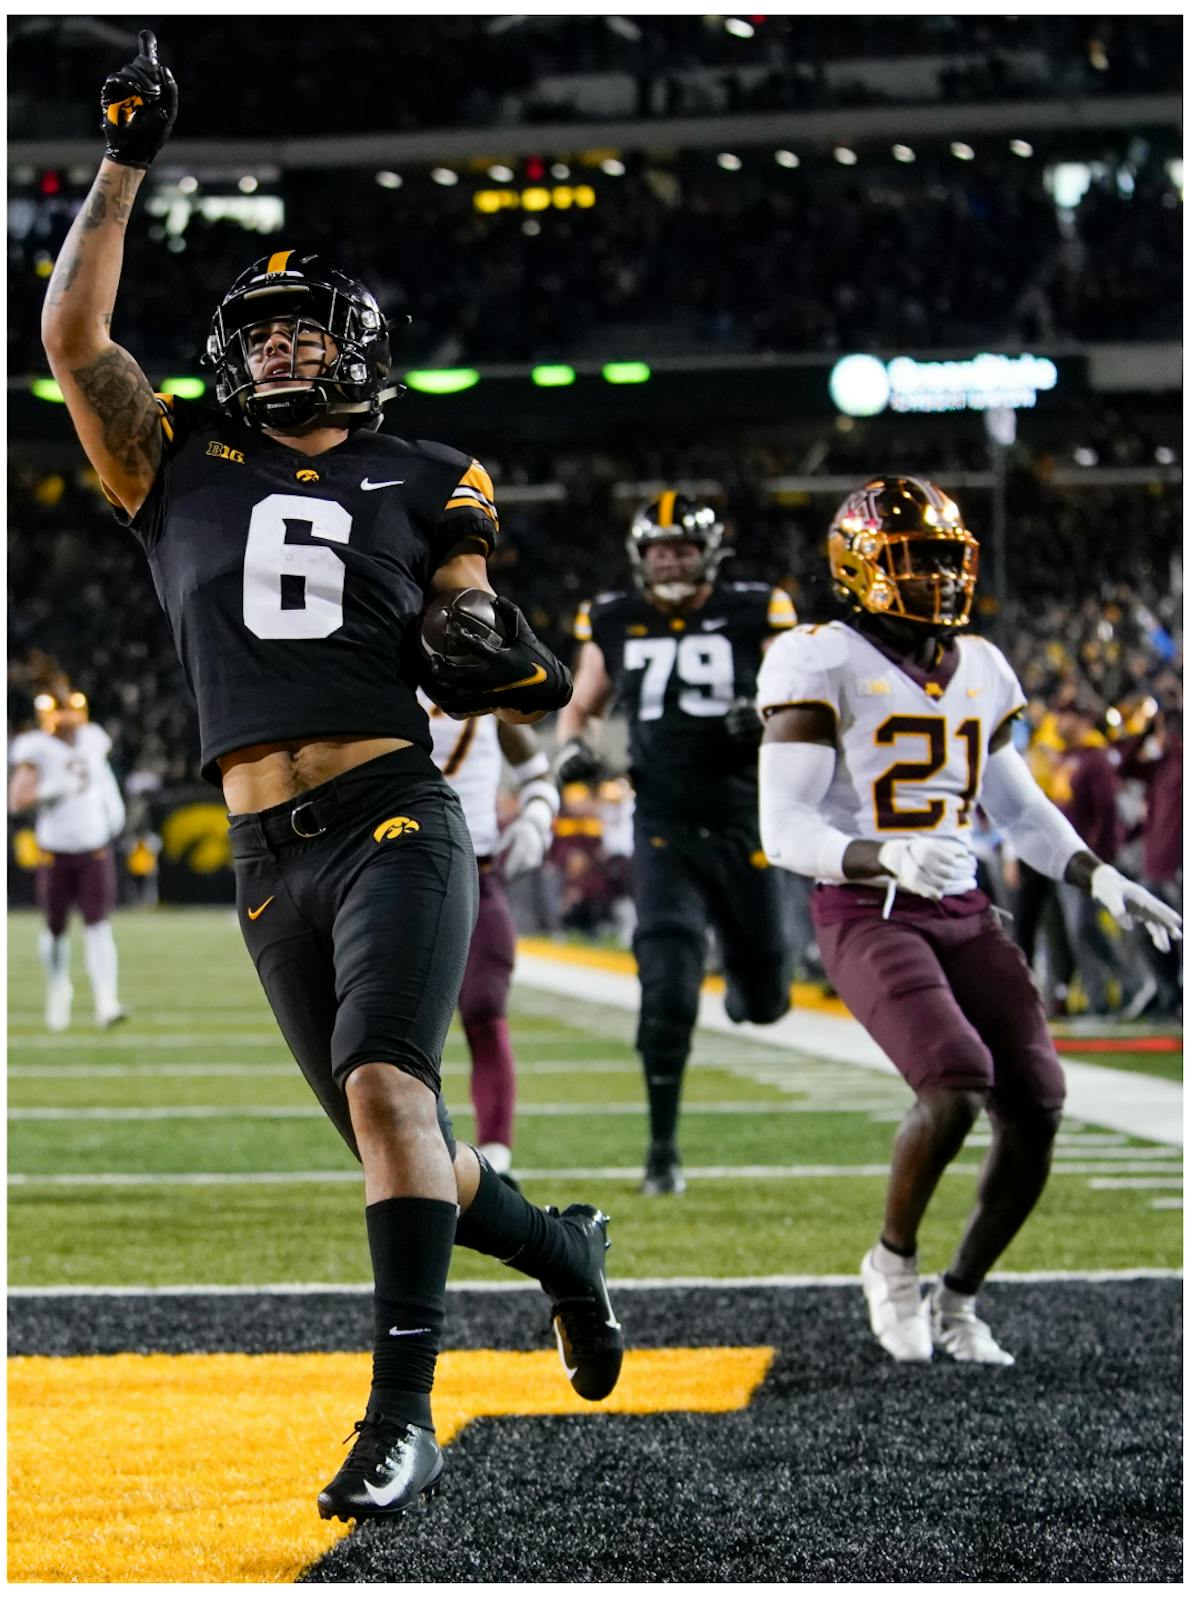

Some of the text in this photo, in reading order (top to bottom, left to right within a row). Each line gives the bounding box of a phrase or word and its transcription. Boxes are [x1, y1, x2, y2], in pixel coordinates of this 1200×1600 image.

[242, 493, 354, 640] 6
[623, 633, 735, 722] 79
[872, 712, 982, 833] 21
